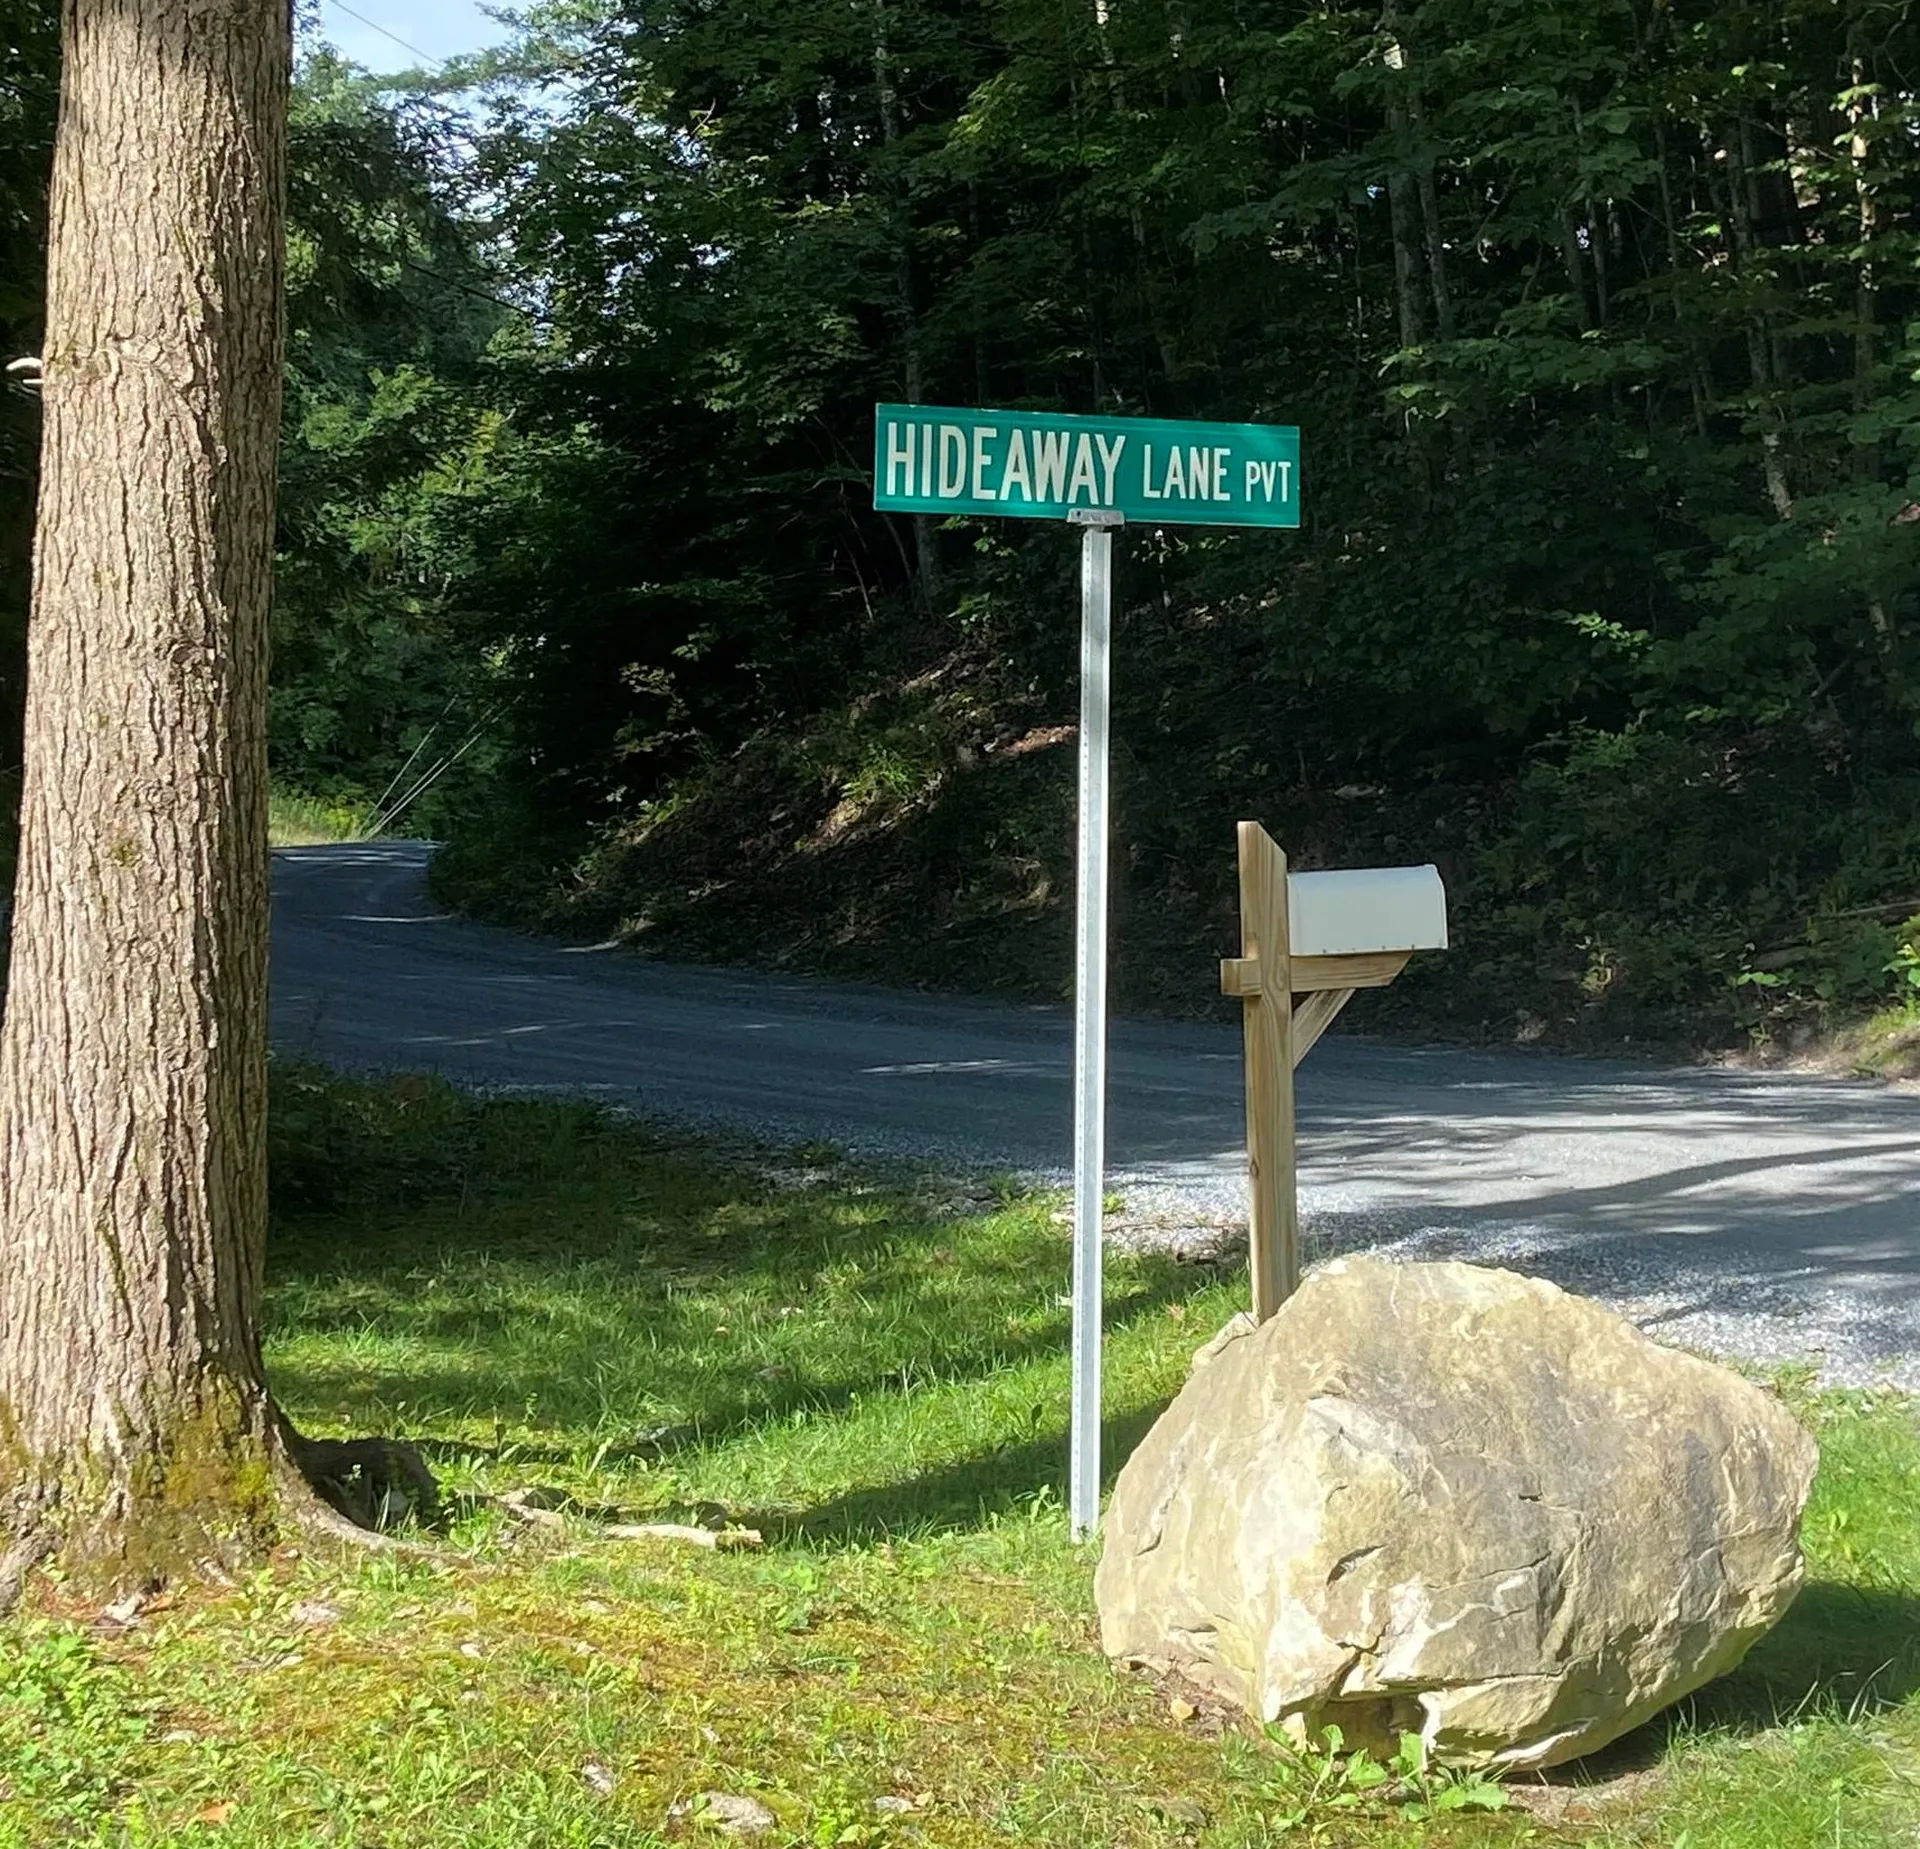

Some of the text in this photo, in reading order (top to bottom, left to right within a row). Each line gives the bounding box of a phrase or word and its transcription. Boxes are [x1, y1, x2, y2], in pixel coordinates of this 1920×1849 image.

[887, 422, 1292, 506] HIDEAWAY LANE PVT
